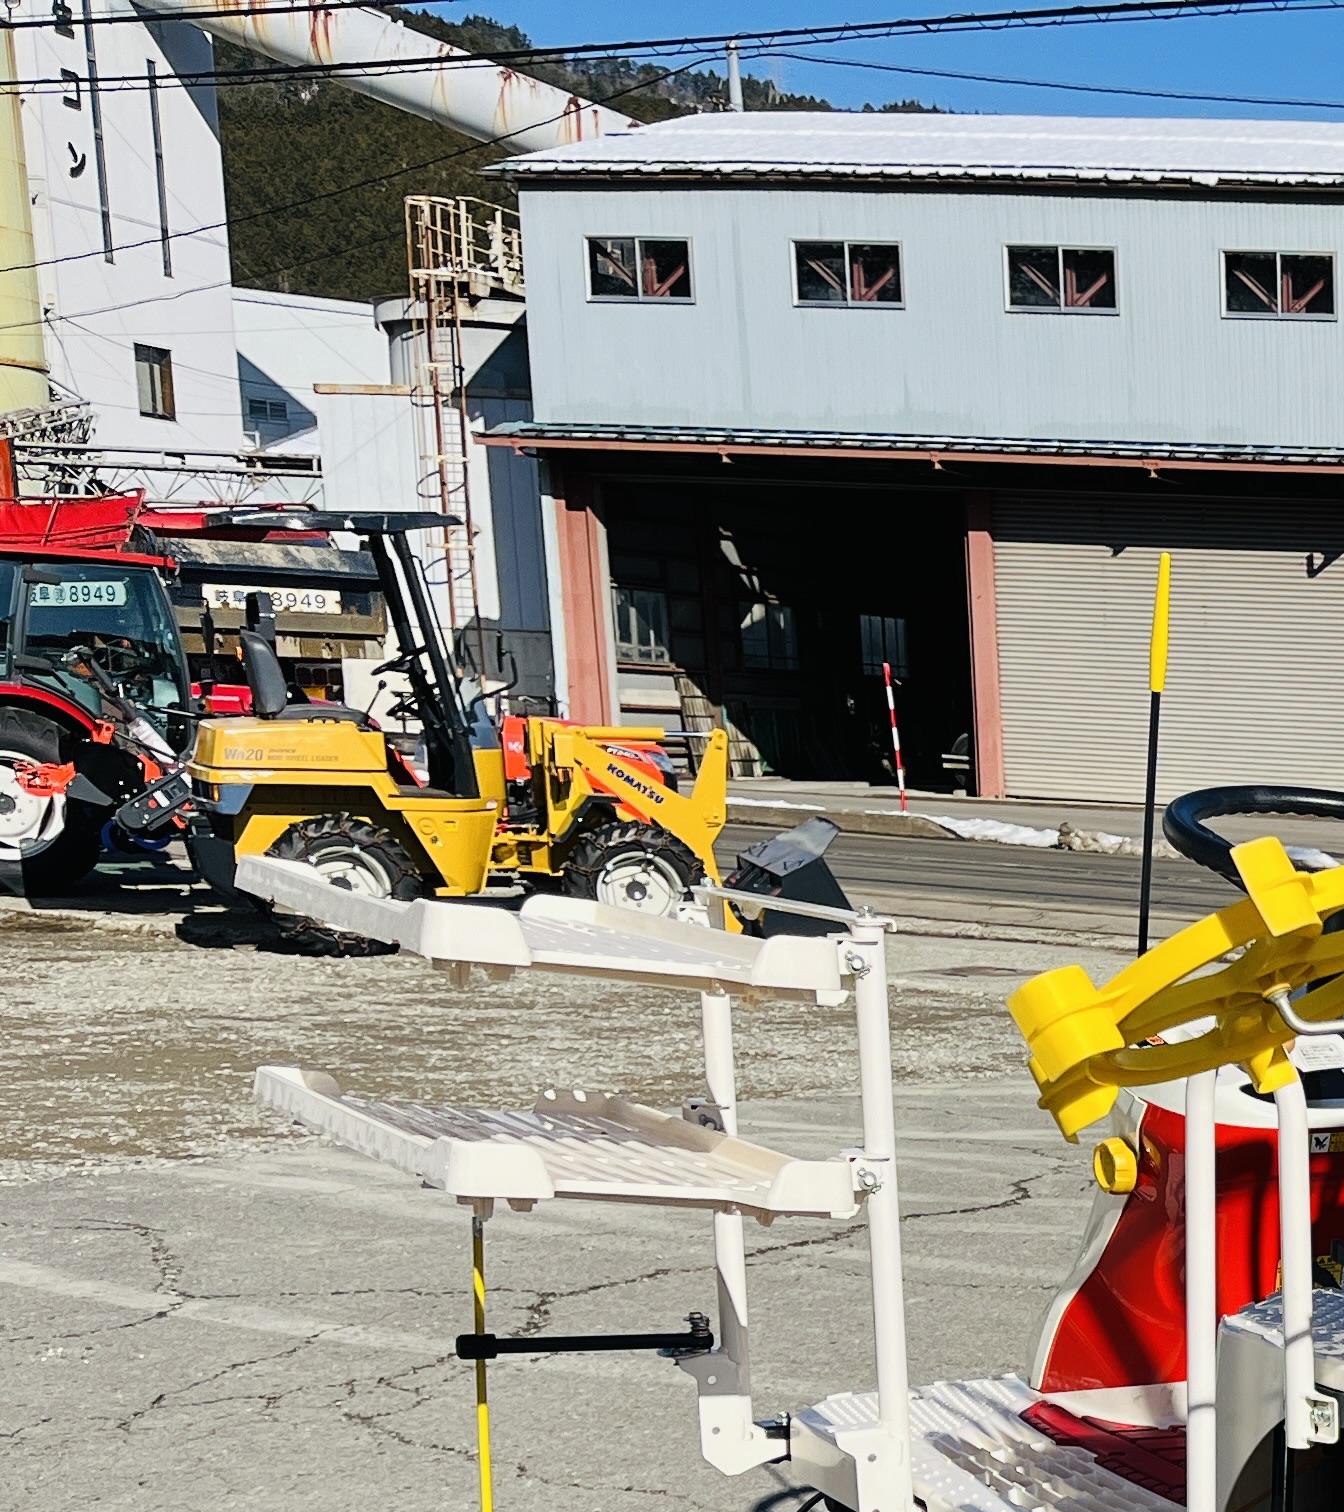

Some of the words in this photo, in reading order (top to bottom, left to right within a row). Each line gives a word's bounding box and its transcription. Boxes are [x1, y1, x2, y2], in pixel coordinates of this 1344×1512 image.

[69, 584, 116, 603] 8949
[270, 591, 327, 609] 8949
[224, 747, 264, 761] WA20
[607, 763, 665, 804] KOMATSU
